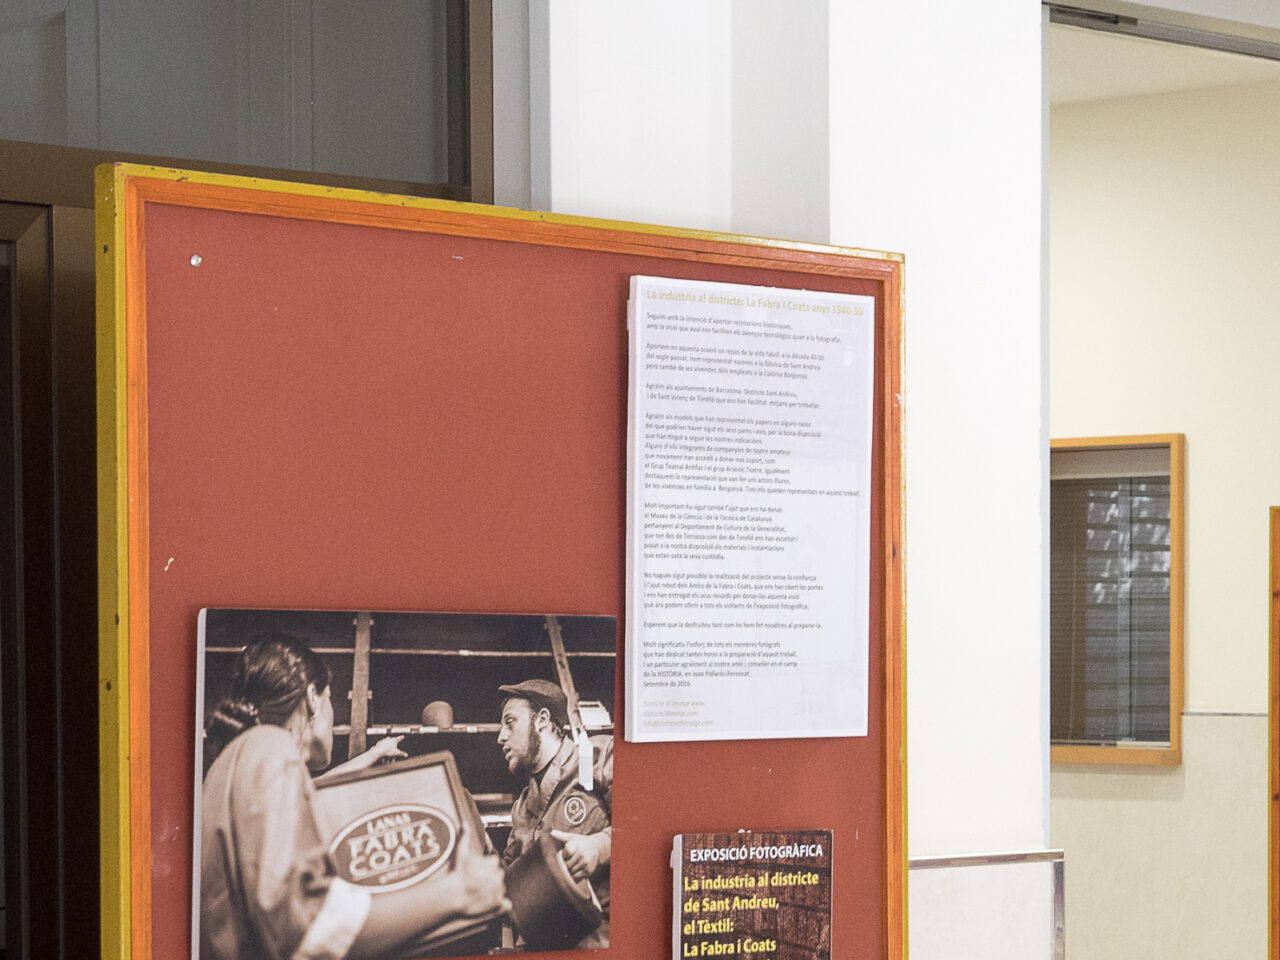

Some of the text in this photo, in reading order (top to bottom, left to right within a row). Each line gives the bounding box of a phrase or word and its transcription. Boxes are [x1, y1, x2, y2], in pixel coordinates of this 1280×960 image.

[646, 289, 657, 299] La
[658, 290, 696, 302] industria
[698, 293, 706, 303] al
[708, 294, 744, 306] districte:
[746, 298, 756, 307] La
[757, 298, 781, 309] Fabra
[787, 301, 810, 312] Coats
[811, 305, 830, 316] anys
[832, 305, 864, 316] 1940-50
[348, 821, 434, 859] FABRA
[349, 837, 440, 877] COATS
[690, 842, 823, 862] EXPOSICIÓ FOTOGRÀFICA
[684, 870, 819, 890] La industria al districte
[684, 894, 779, 913] de Sant Andreu,
[684, 918, 734, 935] el Tèxtil:
[684, 938, 776, 957] La Fabra i Coats
